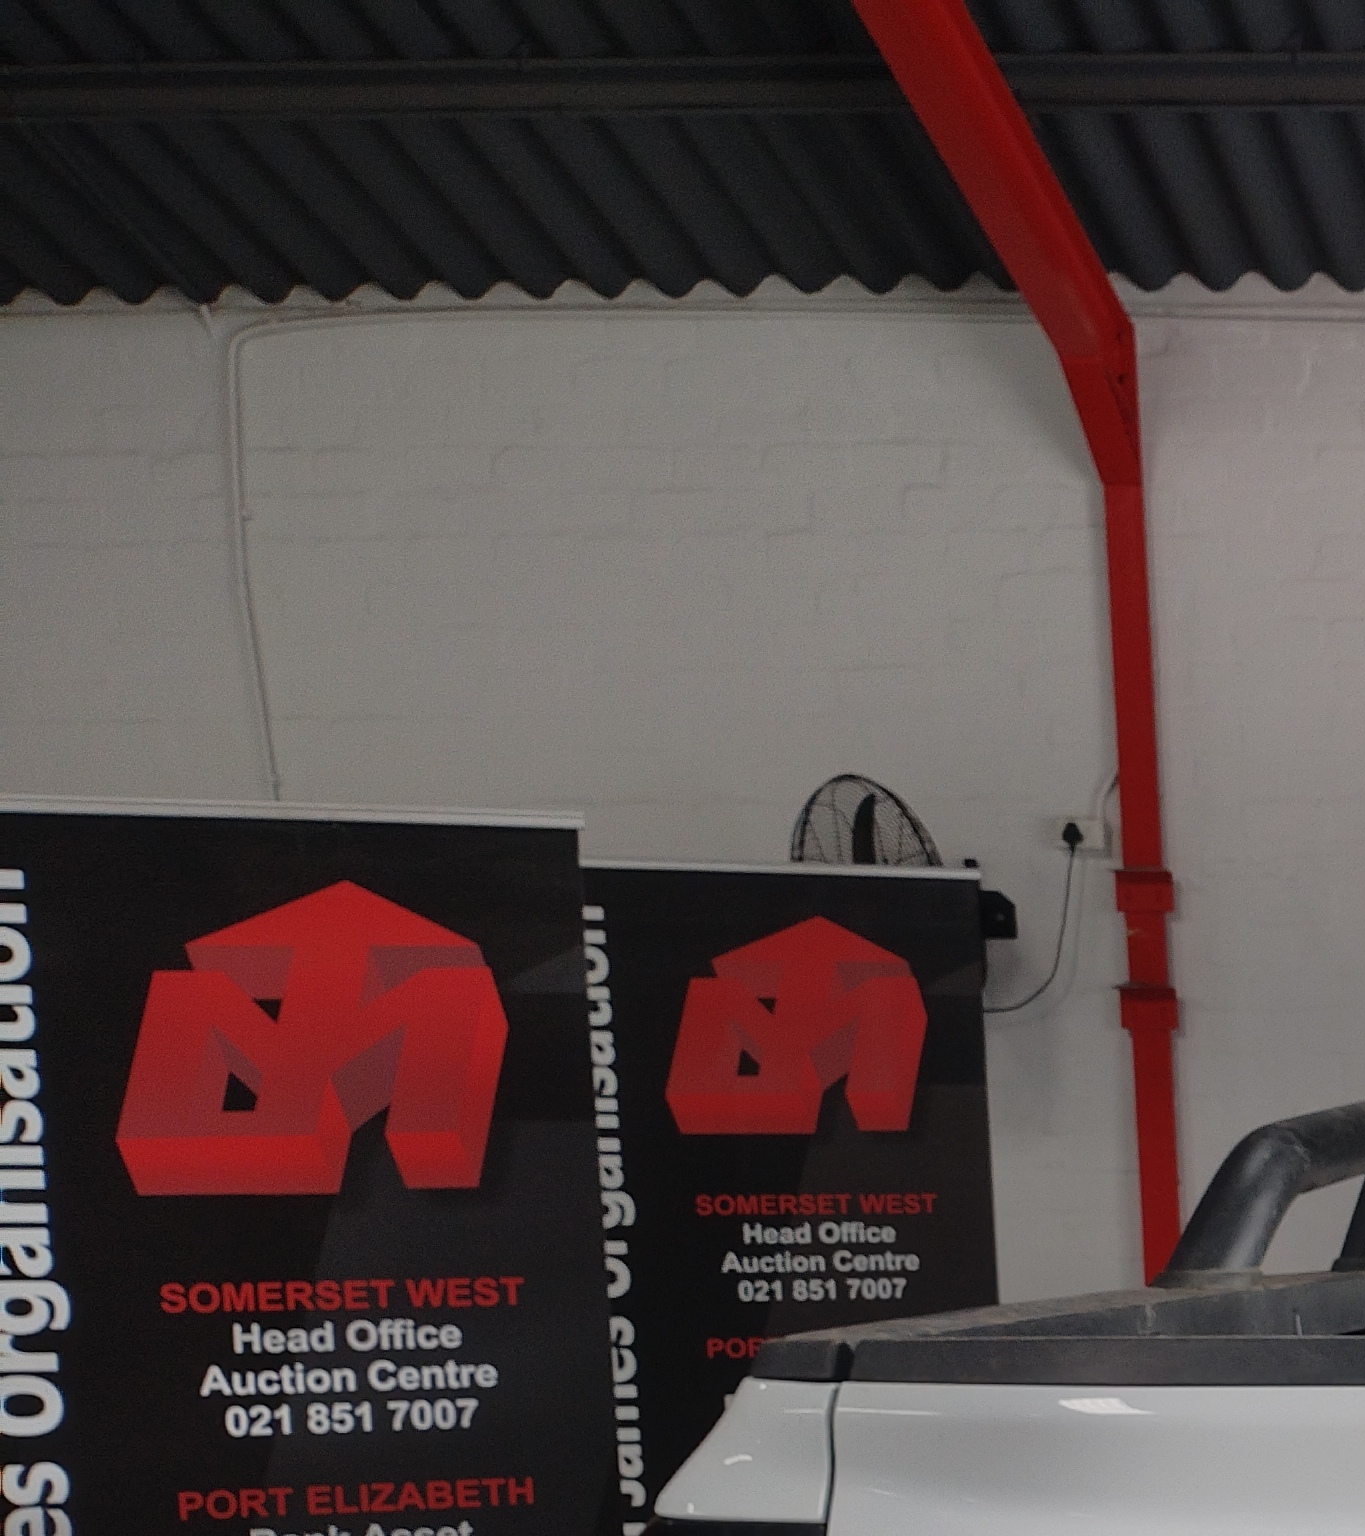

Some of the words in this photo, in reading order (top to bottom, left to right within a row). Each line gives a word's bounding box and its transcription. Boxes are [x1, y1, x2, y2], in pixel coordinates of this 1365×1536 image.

[696, 1194, 849, 1215] SOMERSET
[860, 1194, 935, 1213] WEST
[743, 1222, 812, 1244] Head
[819, 1222, 896, 1243] Office
[722, 1251, 826, 1273] Auction
[833, 1250, 919, 1272] Centre
[161, 1279, 394, 1313] SOMERSET
[406, 1277, 523, 1307] WEST
[738, 1280, 782, 1302] 021
[793, 1279, 836, 1301] 851
[846, 1278, 906, 1299] 7007
[233, 1321, 335, 1353] Head
[346, 1318, 462, 1351] Office
[200, 1362, 356, 1396] Auction
[368, 1360, 498, 1391] Centre
[225, 1404, 292, 1437] 021
[307, 1402, 372, 1434] 851
[387, 1398, 478, 1431] 7007
[178, 1487, 292, 1520] PORT
[307, 1477, 534, 1515] ELIZABETH
